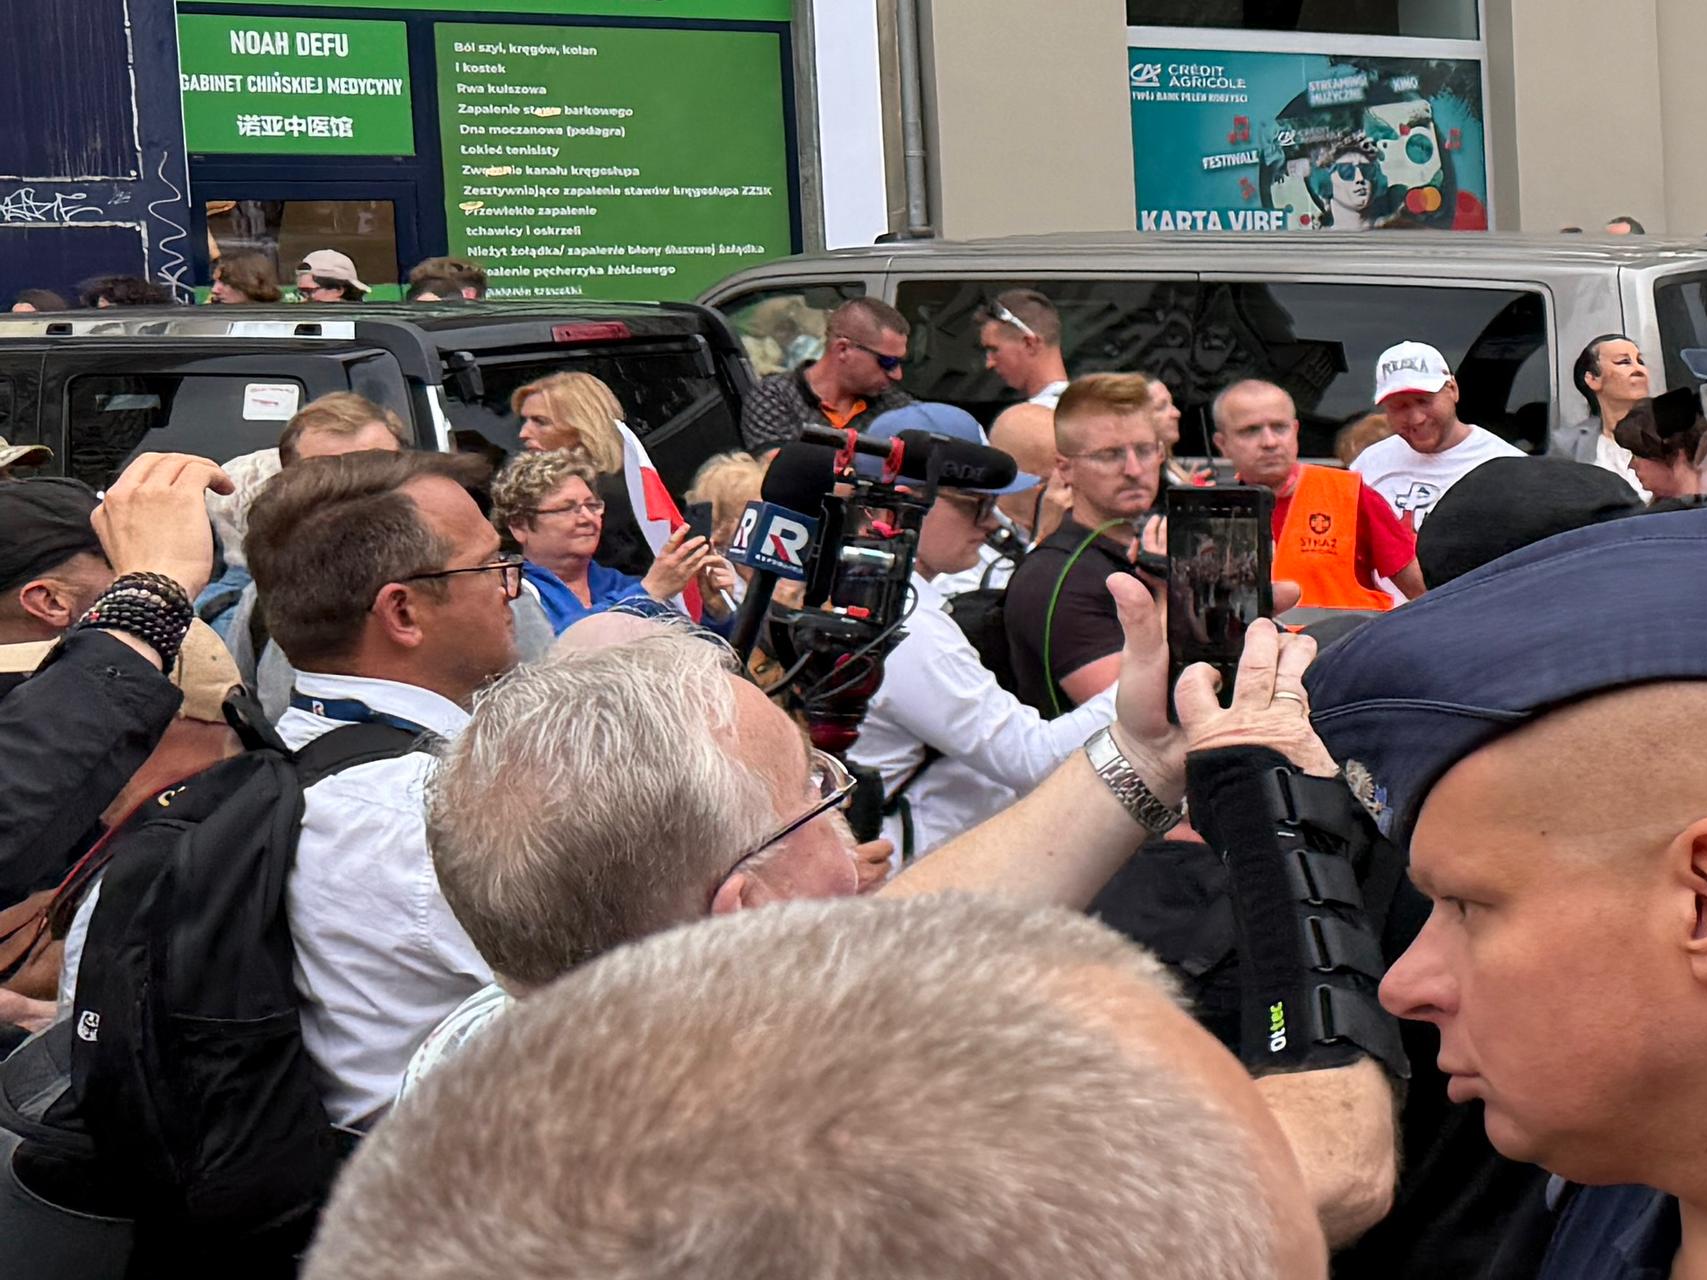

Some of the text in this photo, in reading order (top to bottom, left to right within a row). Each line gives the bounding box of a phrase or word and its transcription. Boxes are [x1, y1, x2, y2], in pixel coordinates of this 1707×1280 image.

[230, 30, 349, 57] NOAH DEFU
[562, 45, 598, 56] kolan
[463, 63, 506, 73] kostek
[1168, 64, 1224, 77] CRÉDIT
[181, 71, 402, 96] GABINET CHIŃSKIEJ MEDYCYNY
[456, 83, 485, 94] Rwa
[1169, 77, 1247, 89] AGRICOLE
[458, 104, 520, 116] Zapalenie
[236, 114, 354, 138] 诺亚中医馆
[459, 124, 485, 134] Dna
[489, 125, 563, 135] moczanowa
[760, 515, 809, 566] R
